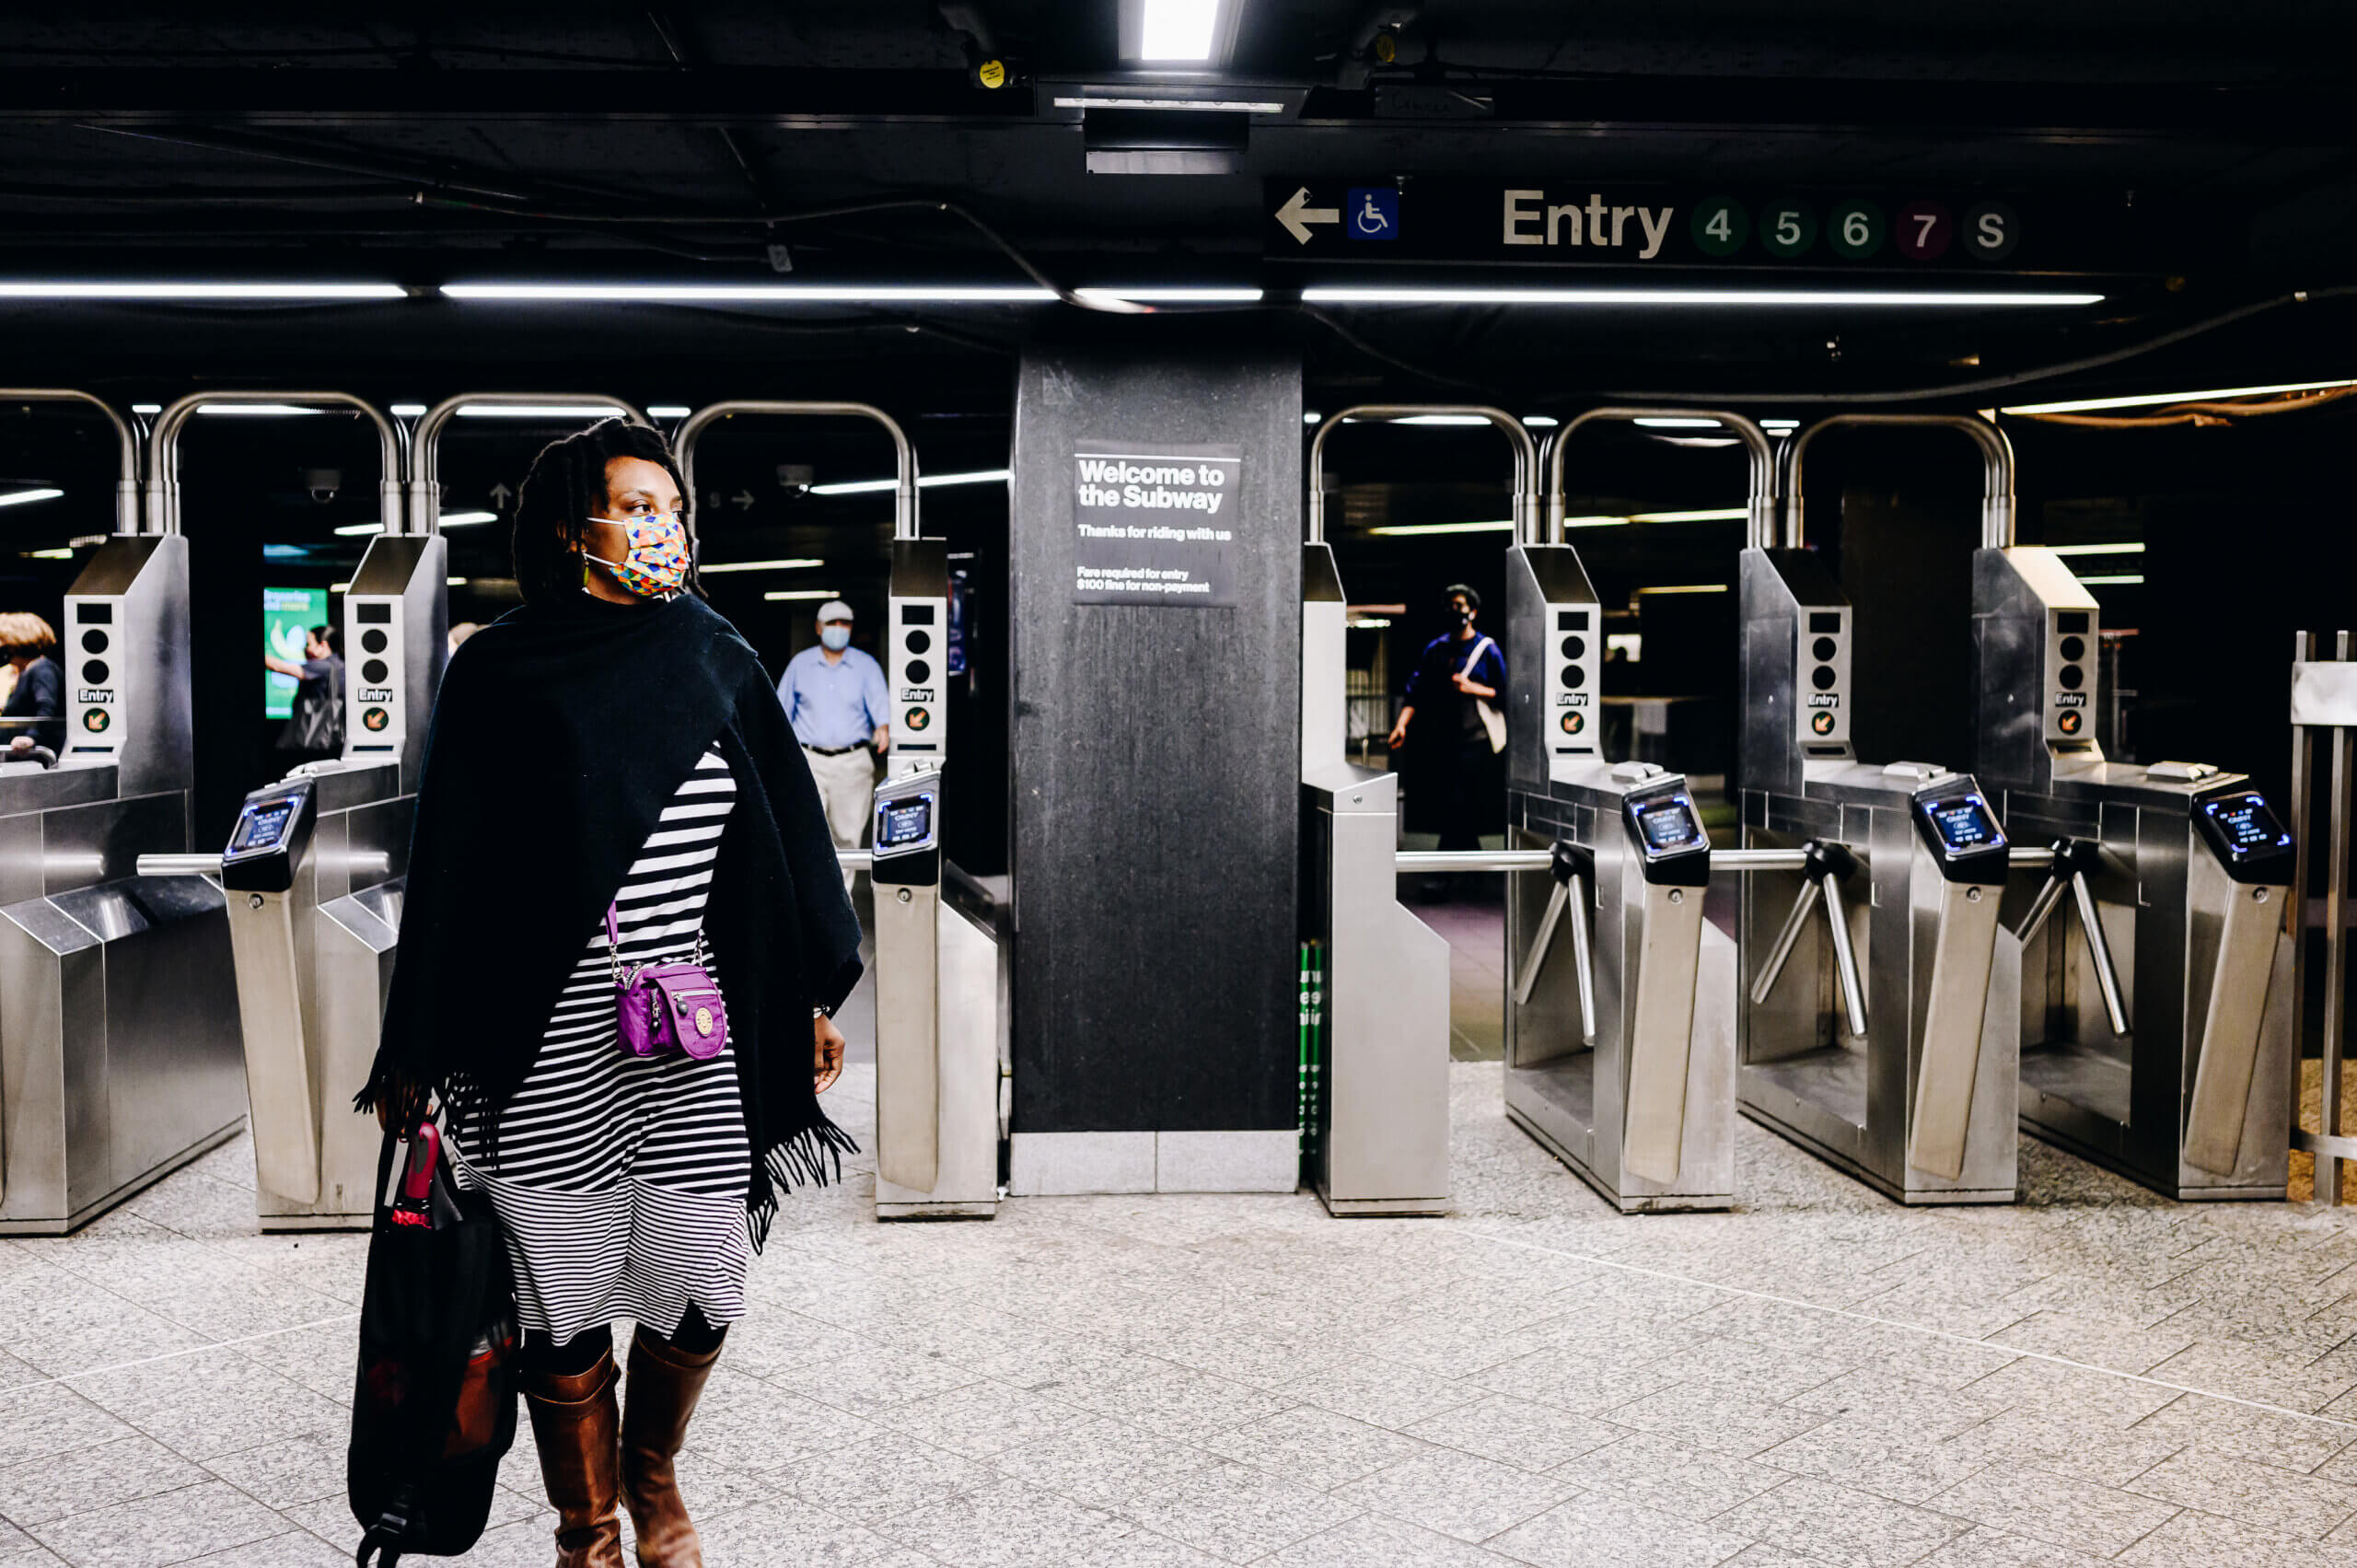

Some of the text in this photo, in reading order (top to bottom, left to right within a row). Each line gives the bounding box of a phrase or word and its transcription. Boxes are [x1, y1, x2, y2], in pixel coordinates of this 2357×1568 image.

[1503, 189, 2004, 260] Entry 4 5 6 7 S
[1079, 460, 1225, 486] Welcome to
[1079, 484, 1223, 514] the Subway
[1077, 524, 1232, 541] Thanks for riding with us
[1077, 566, 1189, 582] Fare required for entry
[1076, 578, 1210, 594] $100 fine for non-payment
[79, 690, 113, 703] Entry
[359, 689, 391, 702] Entry
[901, 689, 933, 702] Entry
[1556, 693, 1587, 706] Entry
[1808, 693, 1838, 708] Entry
[2055, 692, 2084, 707] Entry
